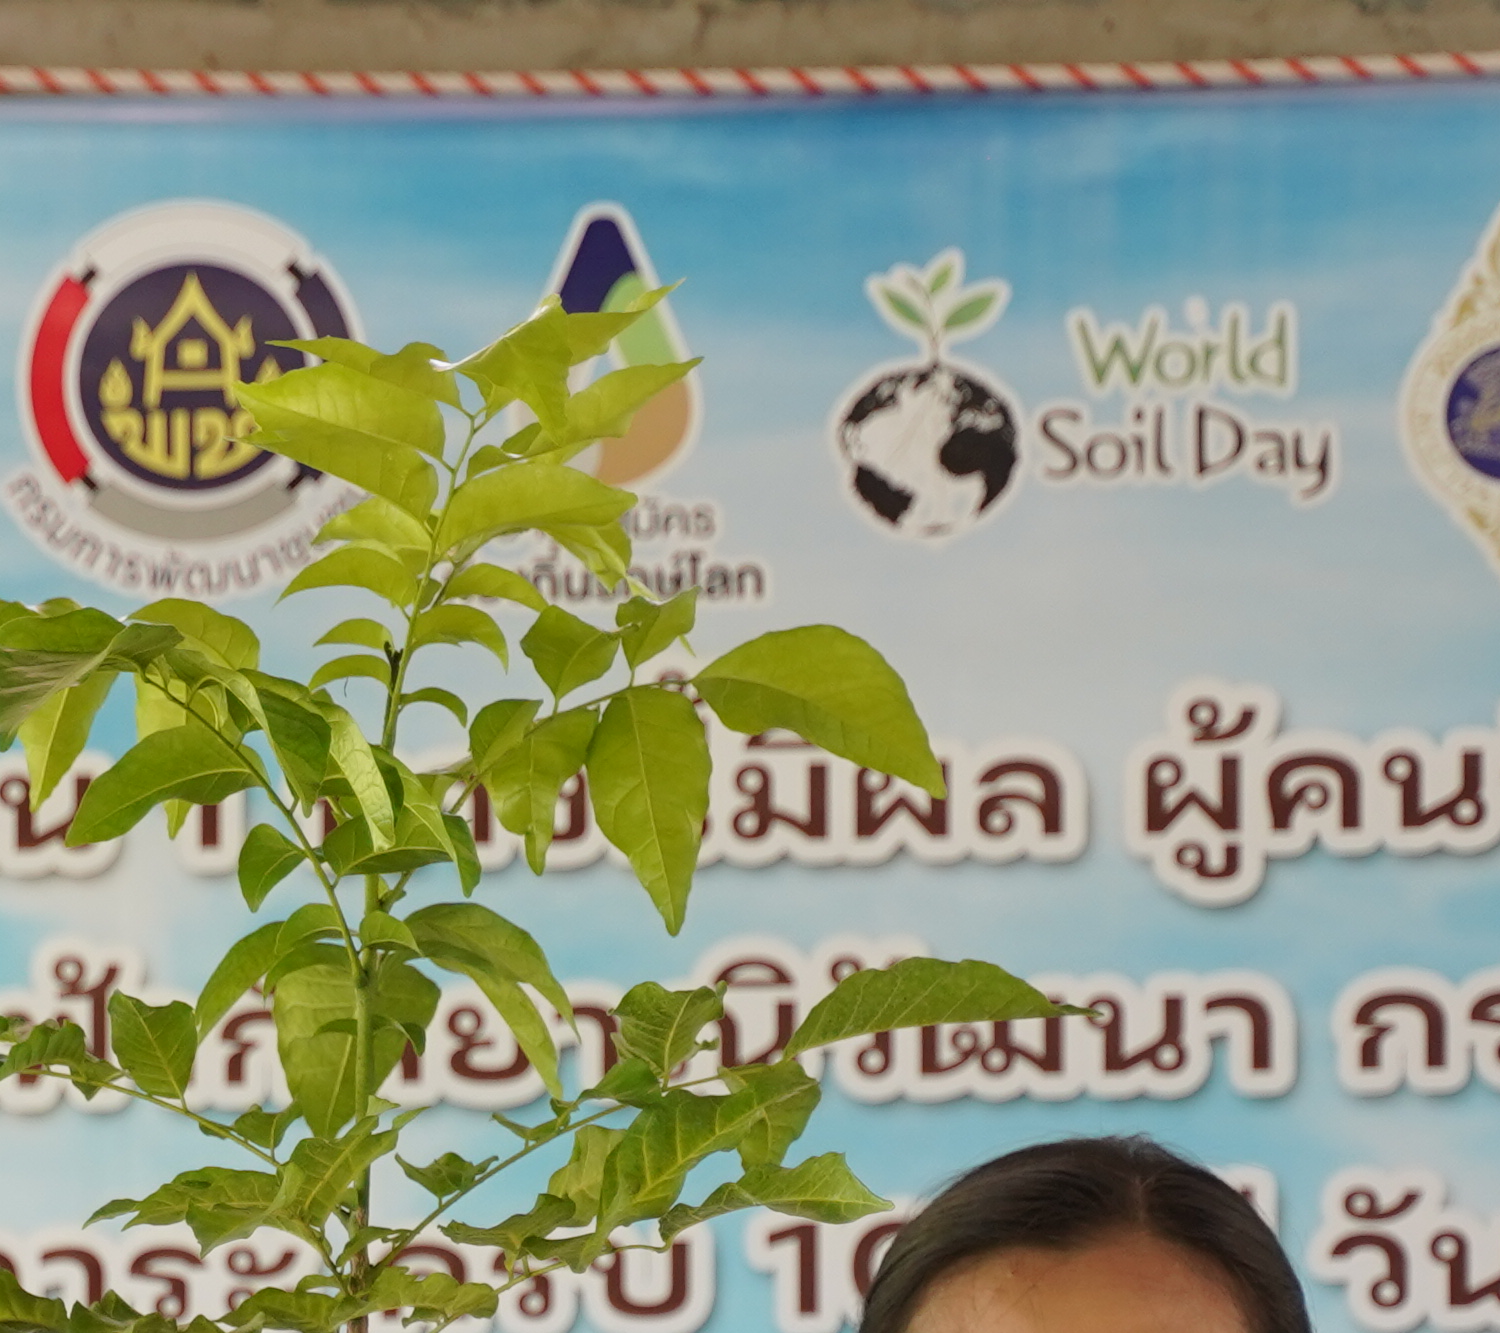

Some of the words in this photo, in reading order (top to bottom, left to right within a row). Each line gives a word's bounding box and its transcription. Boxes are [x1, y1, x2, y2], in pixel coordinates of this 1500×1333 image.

[1072, 308, 1288, 389] World
[1039, 408, 1172, 480] Soil
[1196, 408, 1332, 500] Day
